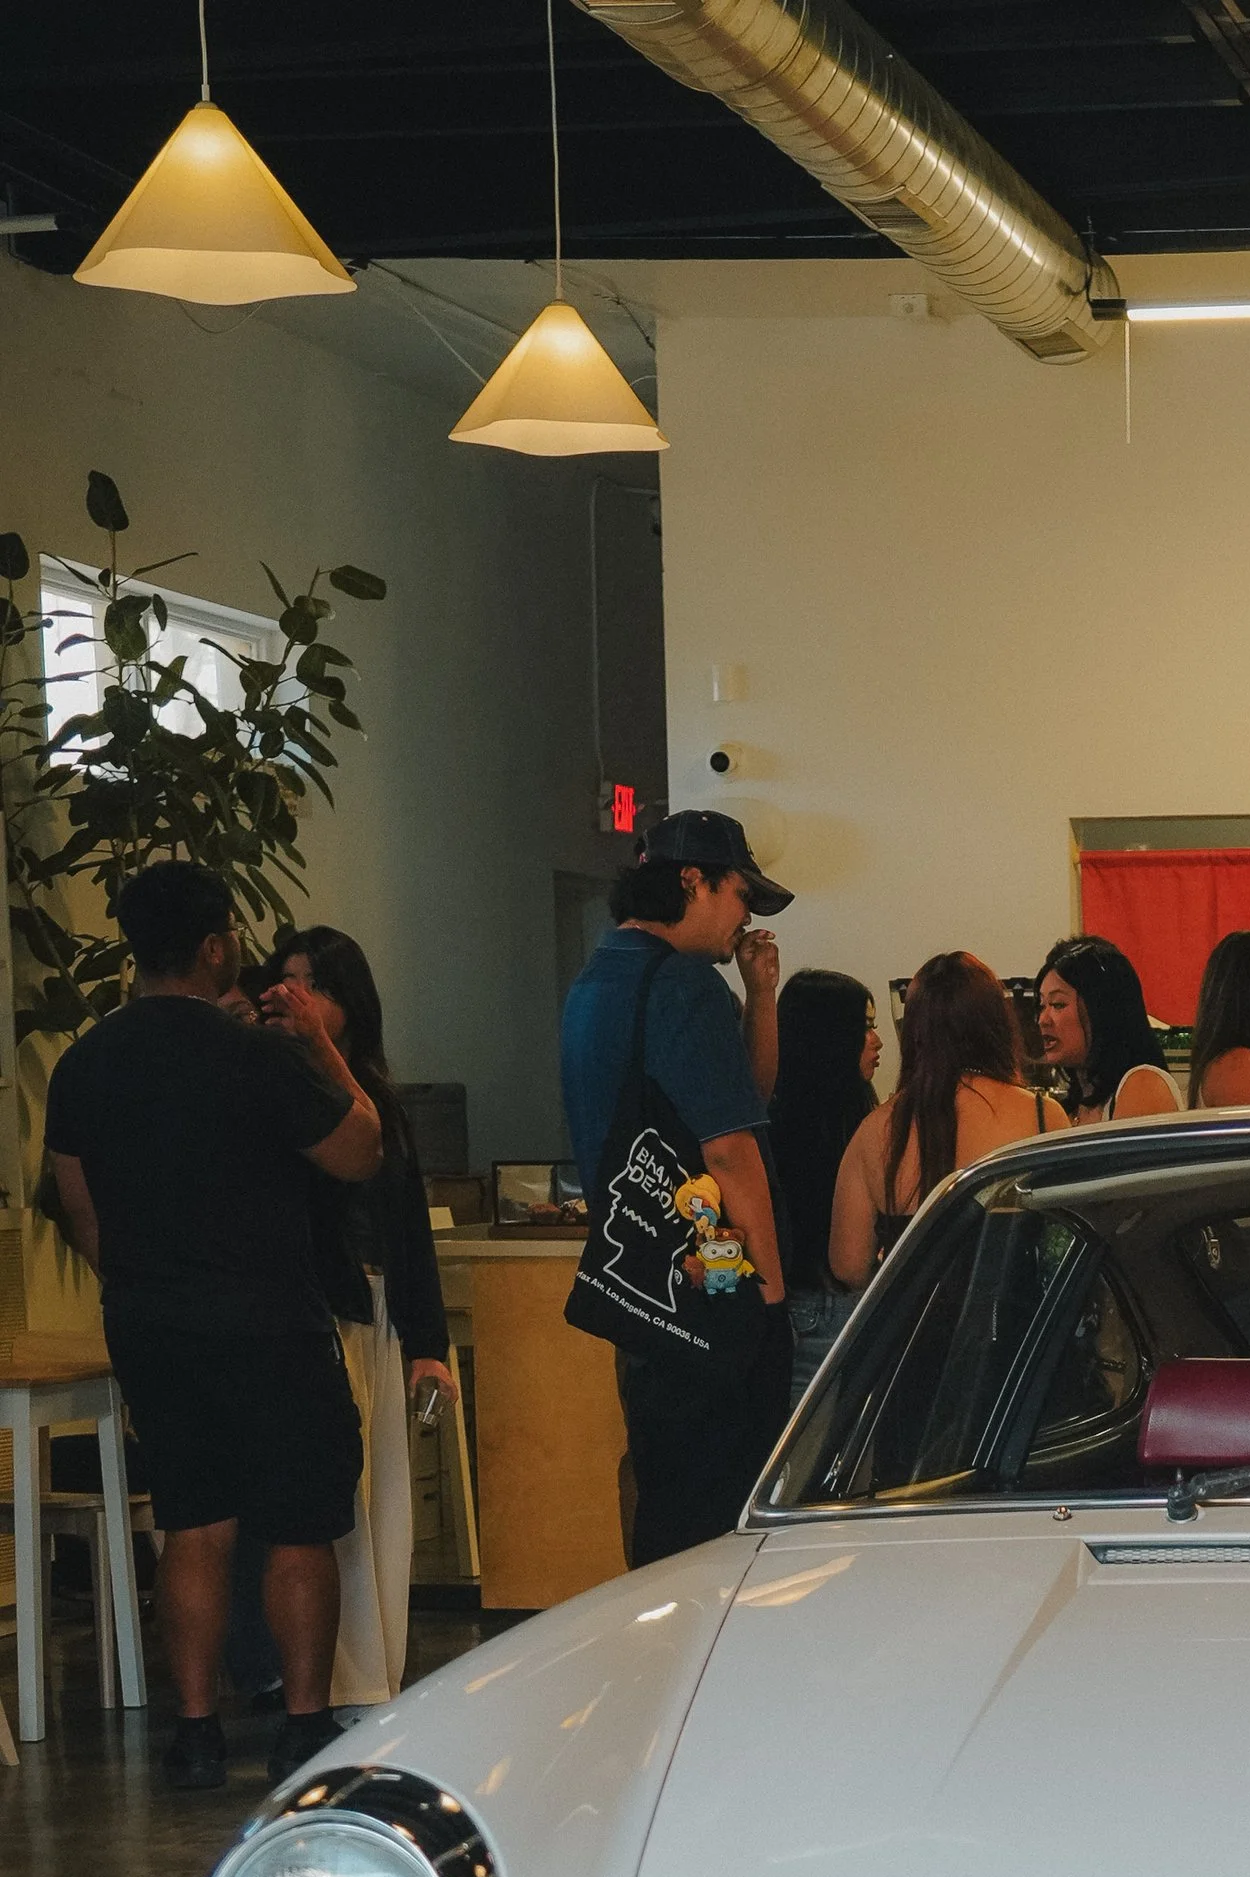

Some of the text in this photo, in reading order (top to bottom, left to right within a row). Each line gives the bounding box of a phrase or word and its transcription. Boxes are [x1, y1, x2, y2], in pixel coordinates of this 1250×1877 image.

[614, 784, 635, 832] EXIT
[590, 1278, 605, 1293] Ave,
[606, 1287, 620, 1302] Los
[619, 1298, 651, 1322] Angeles,
[652, 1316, 665, 1329] CA
[693, 1336, 710, 1351] USA
